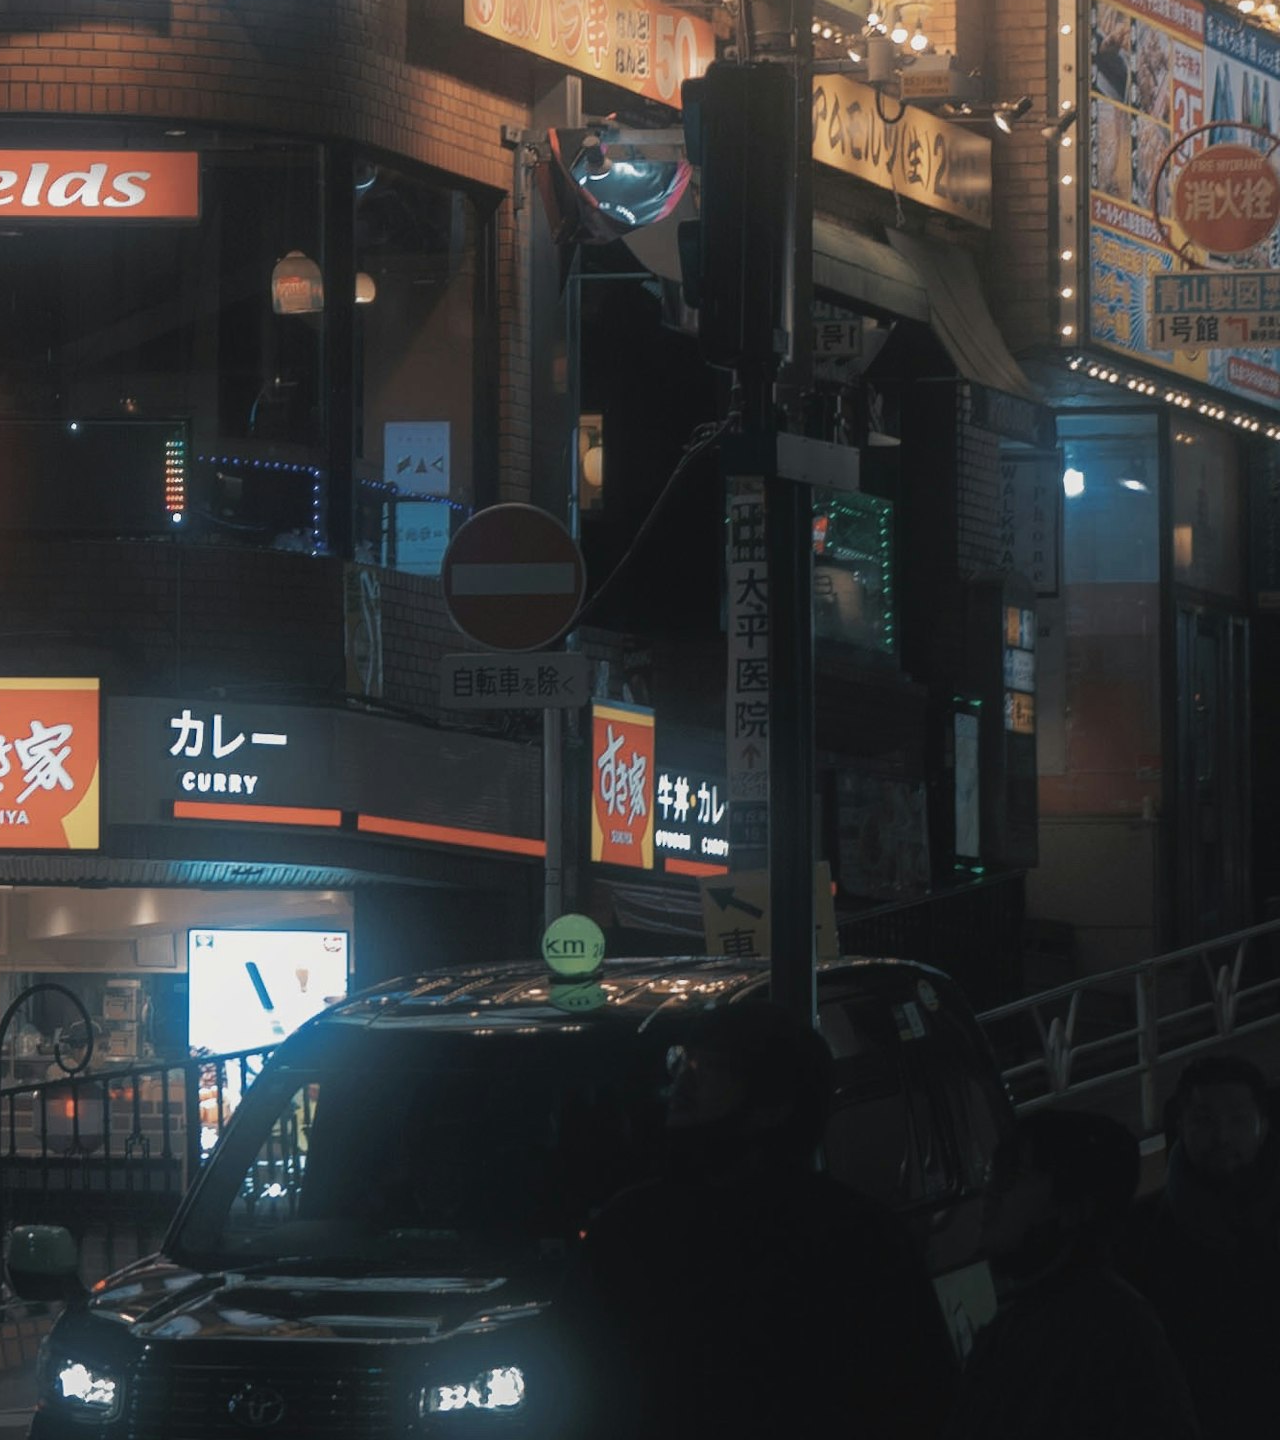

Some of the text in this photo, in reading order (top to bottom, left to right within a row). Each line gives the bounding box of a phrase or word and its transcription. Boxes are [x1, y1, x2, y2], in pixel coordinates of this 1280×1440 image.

[1185, 175, 1274, 221] 消火栓
[1158, 314, 1220, 343] 1号館
[734, 568, 770, 740] 大平医院
[453, 665, 576, 698] 自転車を除く
[169, 708, 288, 759] カレー
[181, 771, 259, 795] CURRY
[597, 723, 647, 827] すき家
[546, 938, 585, 954] km
